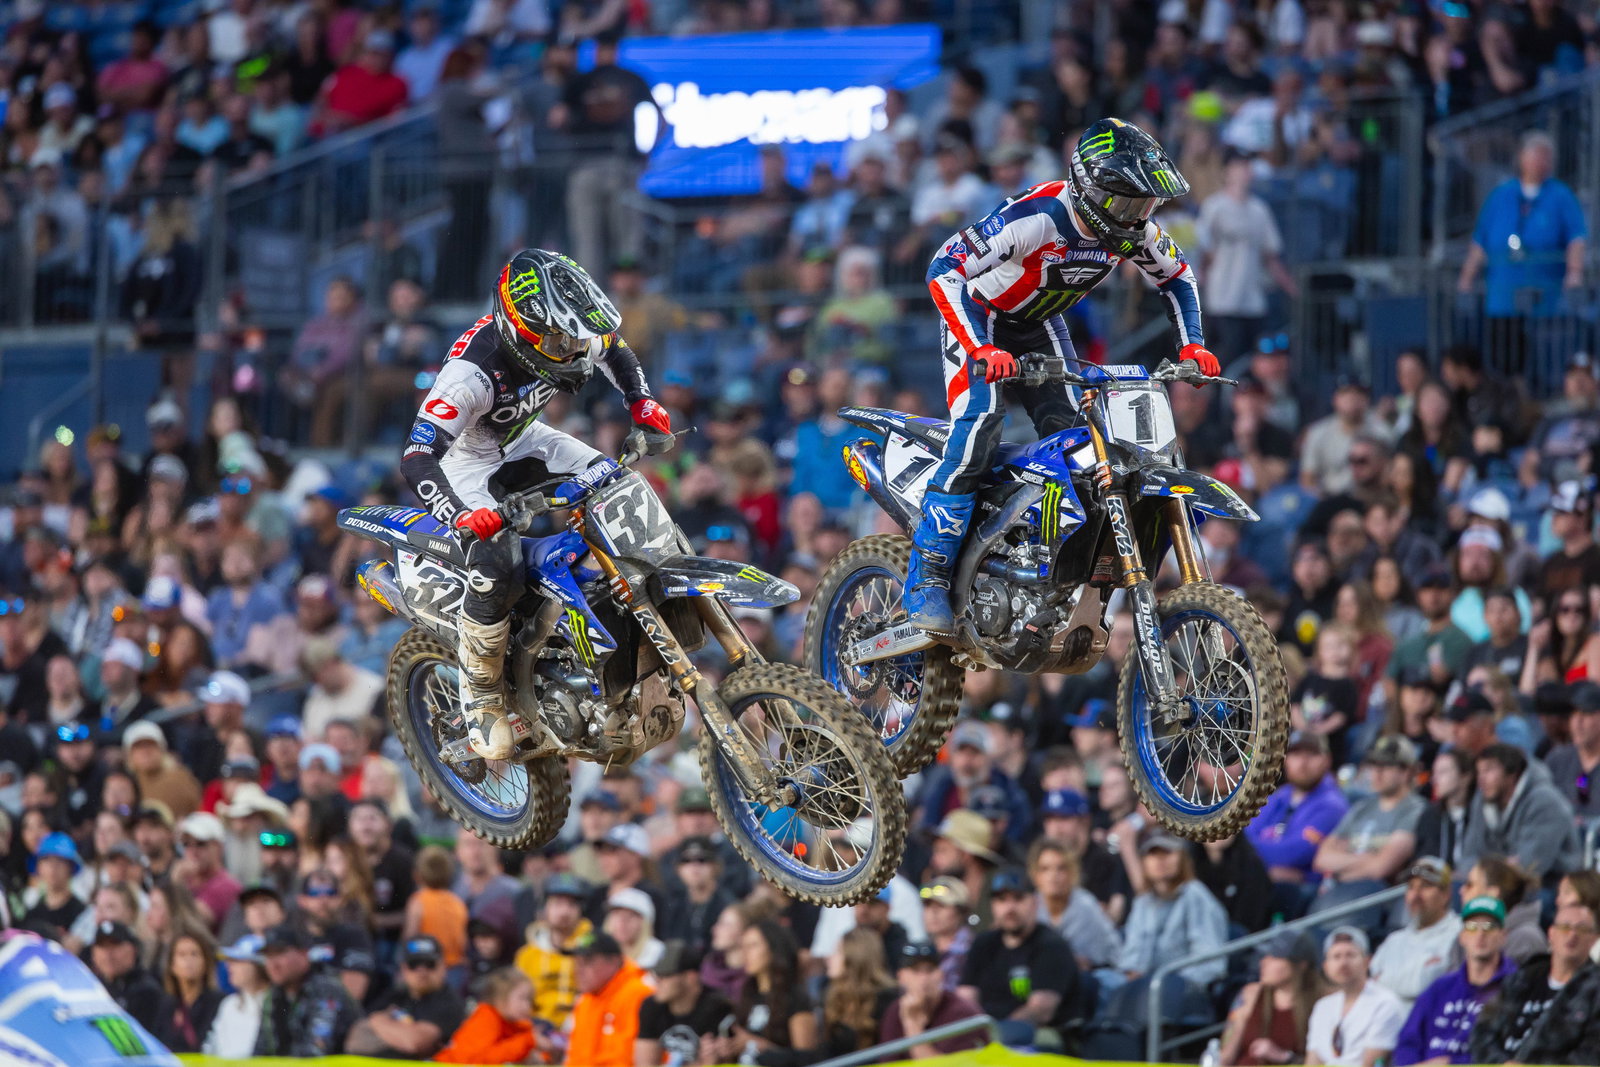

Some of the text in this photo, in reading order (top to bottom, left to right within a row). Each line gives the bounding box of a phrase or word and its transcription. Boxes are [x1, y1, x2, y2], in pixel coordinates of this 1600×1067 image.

[965, 226, 989, 255] YAMALUBE
[1073, 250, 1108, 263] YAMAHA
[501, 282, 526, 331] SCOTT
[1103, 365, 1142, 376] PROTAPER
[844, 409, 881, 421] DUNLOP
[1128, 393, 1157, 444] 1
[889, 456, 938, 494] 1
[1025, 462, 1047, 473] YZ
[344, 517, 385, 533] DUNLOP
[604, 484, 675, 557] 32
[1106, 498, 1134, 556] KYB
[428, 540, 451, 555] YAMAHA
[403, 566, 465, 621] 32
[540, 577, 560, 590] YZ
[1136, 613, 1145, 642] BRAKING
[1140, 601, 1163, 674] DUNLOP
